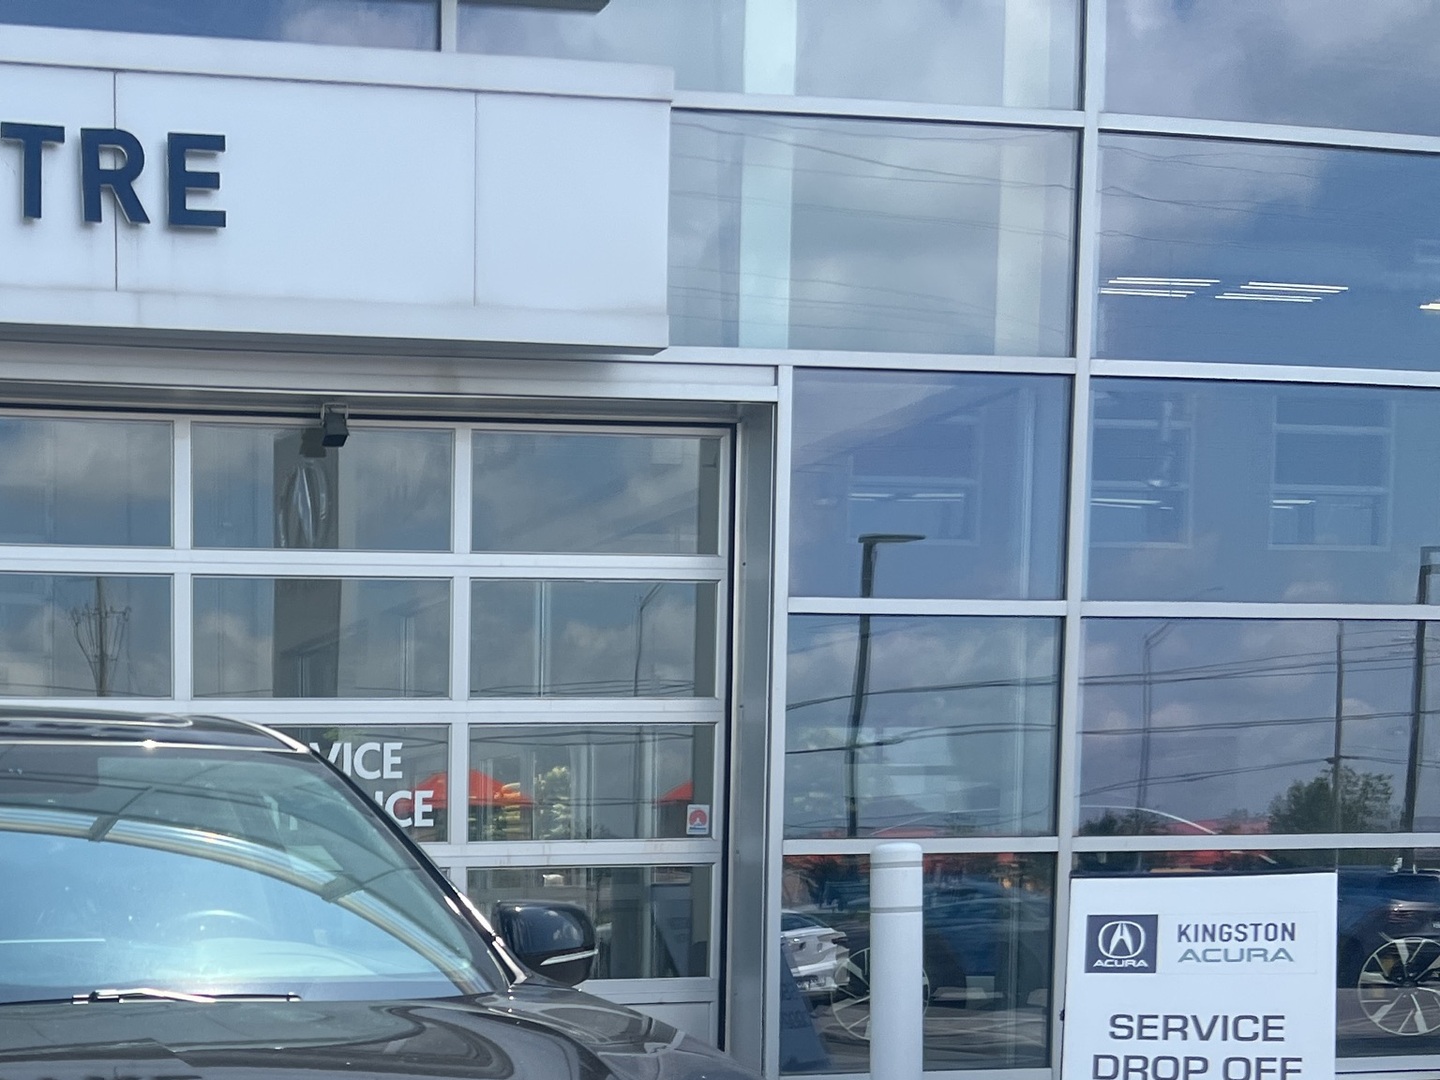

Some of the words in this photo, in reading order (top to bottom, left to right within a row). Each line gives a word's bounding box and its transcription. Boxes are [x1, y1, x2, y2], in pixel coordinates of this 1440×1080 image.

[1177, 922, 1296, 943] KINGSTON
[1092, 959, 1149, 968] ACURA
[1177, 947, 1295, 963] ACURA
[1109, 1014, 1286, 1042] SERVICE
